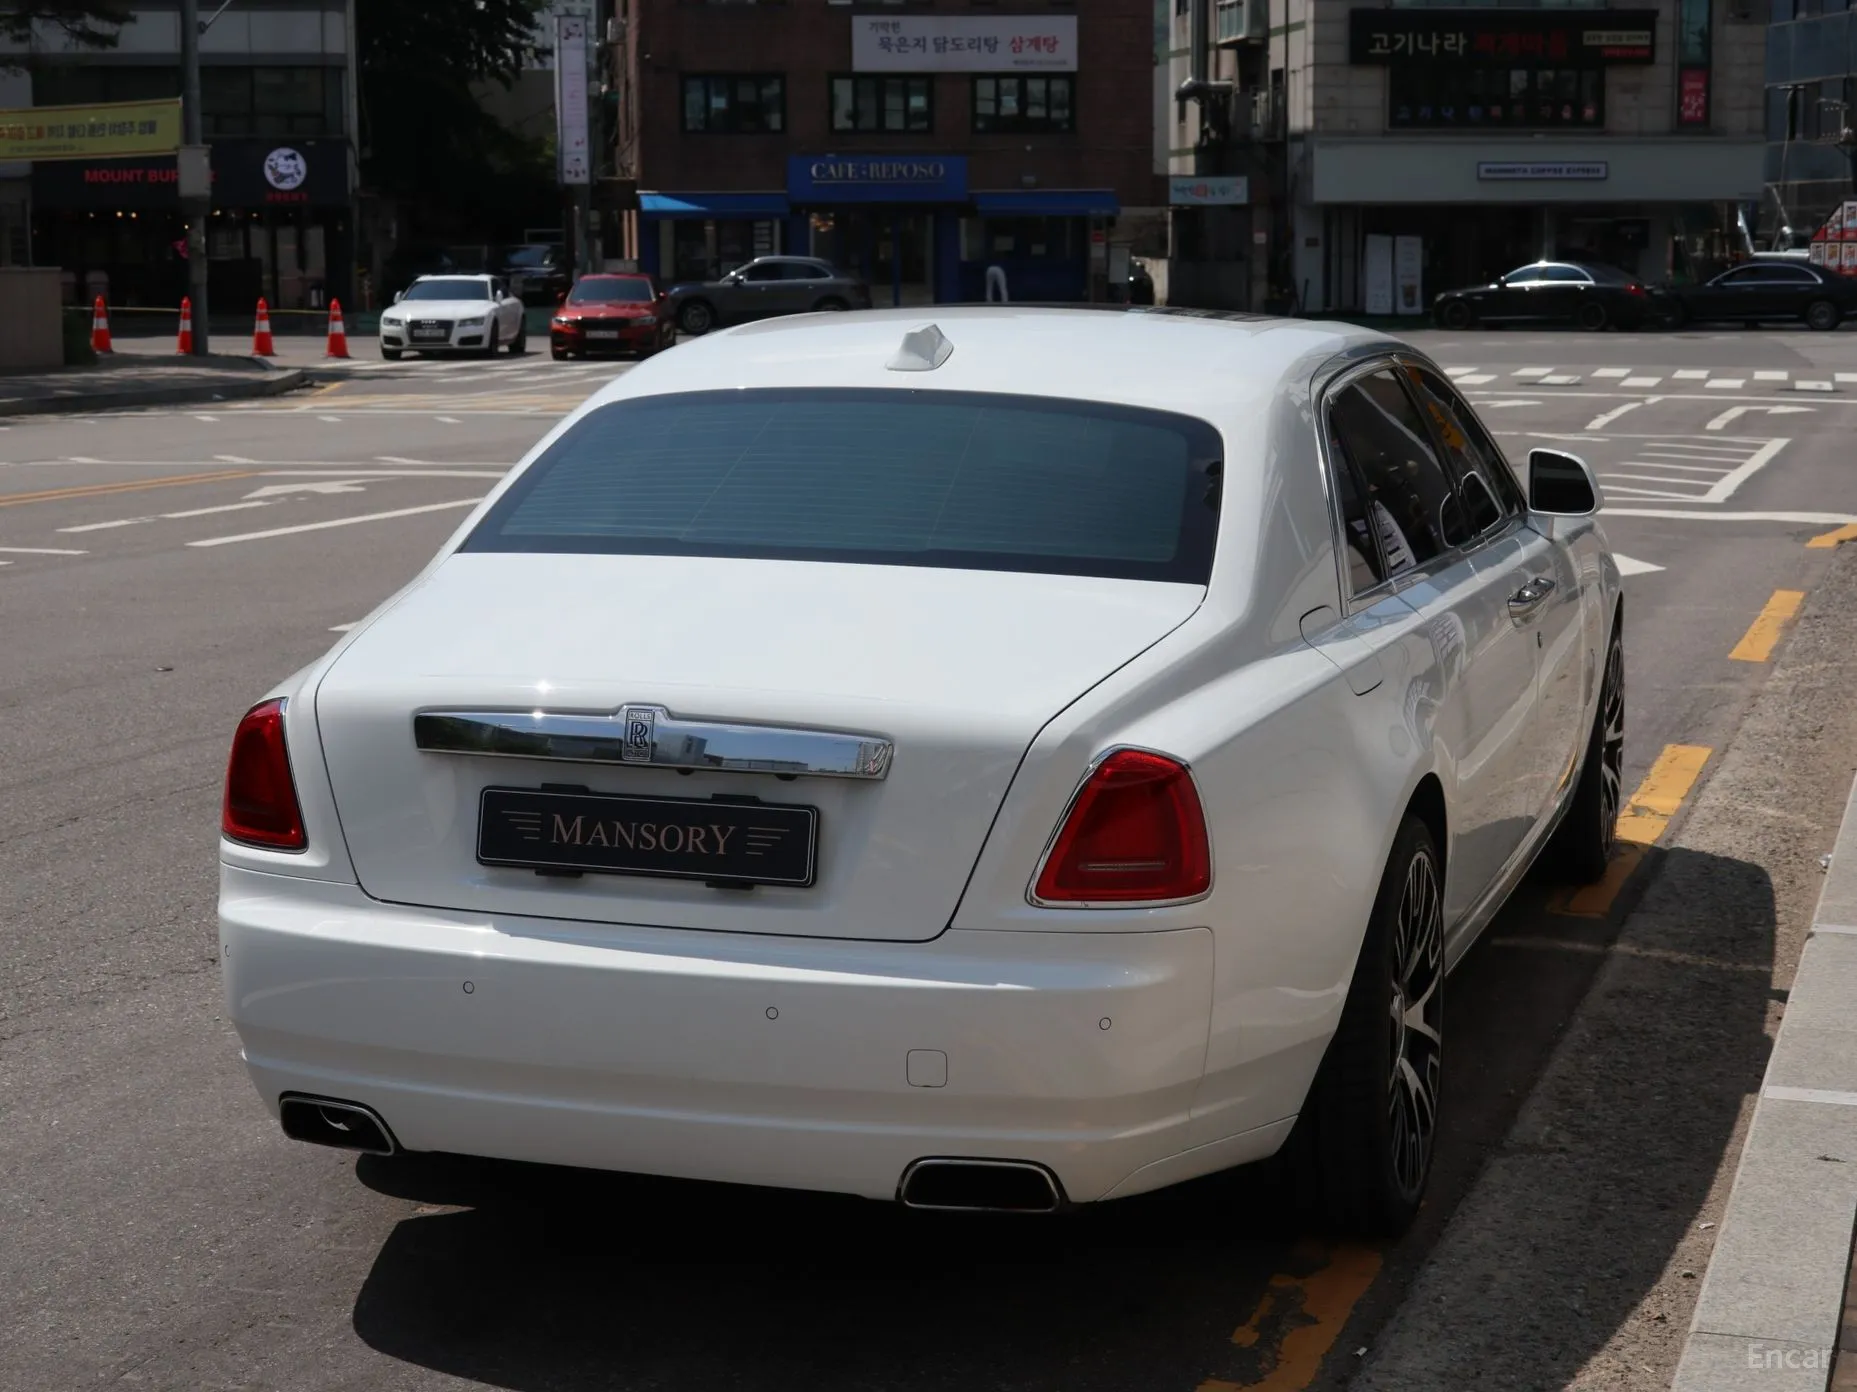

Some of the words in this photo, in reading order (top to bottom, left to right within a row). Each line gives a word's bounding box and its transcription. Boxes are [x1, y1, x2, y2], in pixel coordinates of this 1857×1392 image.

[878, 35, 927, 54] 묵은지
[932, 35, 1000, 54] 닭도리탕
[1367, 31, 1468, 56] 고기나라
[84, 169, 144, 183] MOUNT
[629, 711, 652, 720] ROLLS
[551, 814, 736, 855] MANSORY
